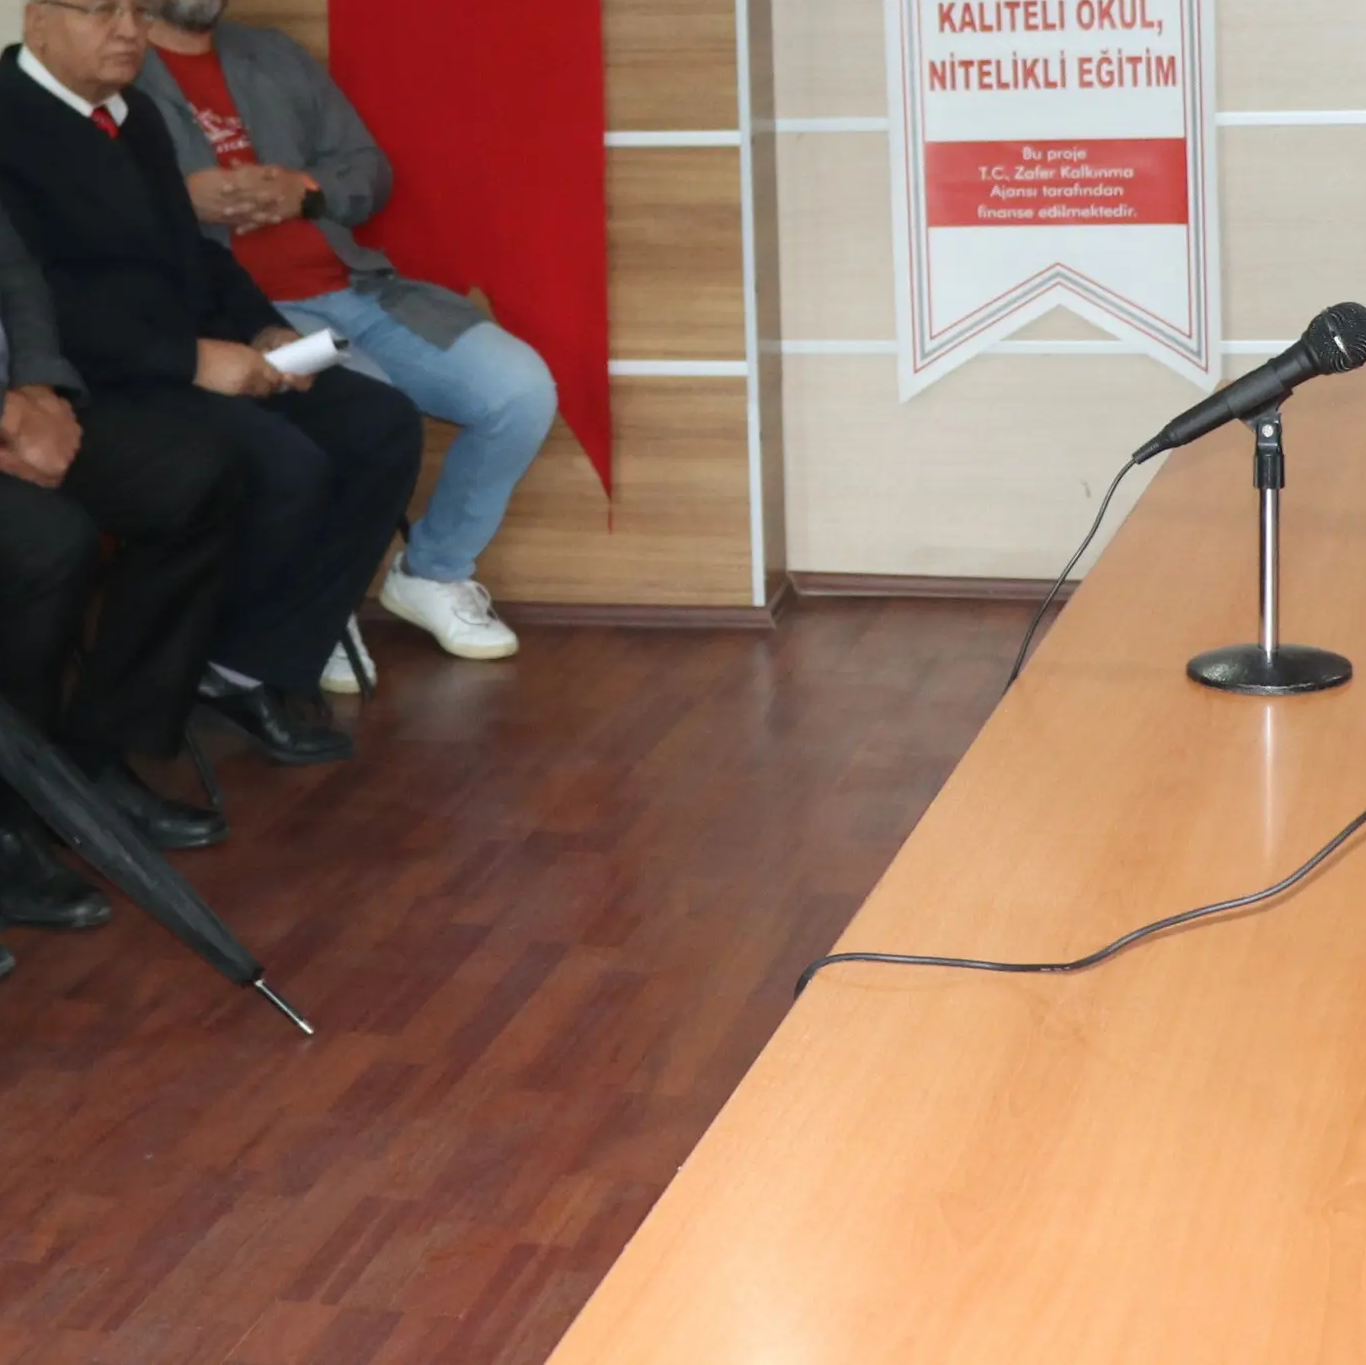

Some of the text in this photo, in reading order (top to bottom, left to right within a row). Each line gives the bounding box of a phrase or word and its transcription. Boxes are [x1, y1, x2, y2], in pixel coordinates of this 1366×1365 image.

[929, 47, 1177, 91] NİTELİKLİ EĞİTİM
[1022, 146, 1087, 162] Bu proje
[978, 164, 1134, 181] T.C. Zafer Kalkınma
[990, 183, 1124, 201] Ajansı tarafından
[977, 204, 1137, 219] finanse edilmektedir.
